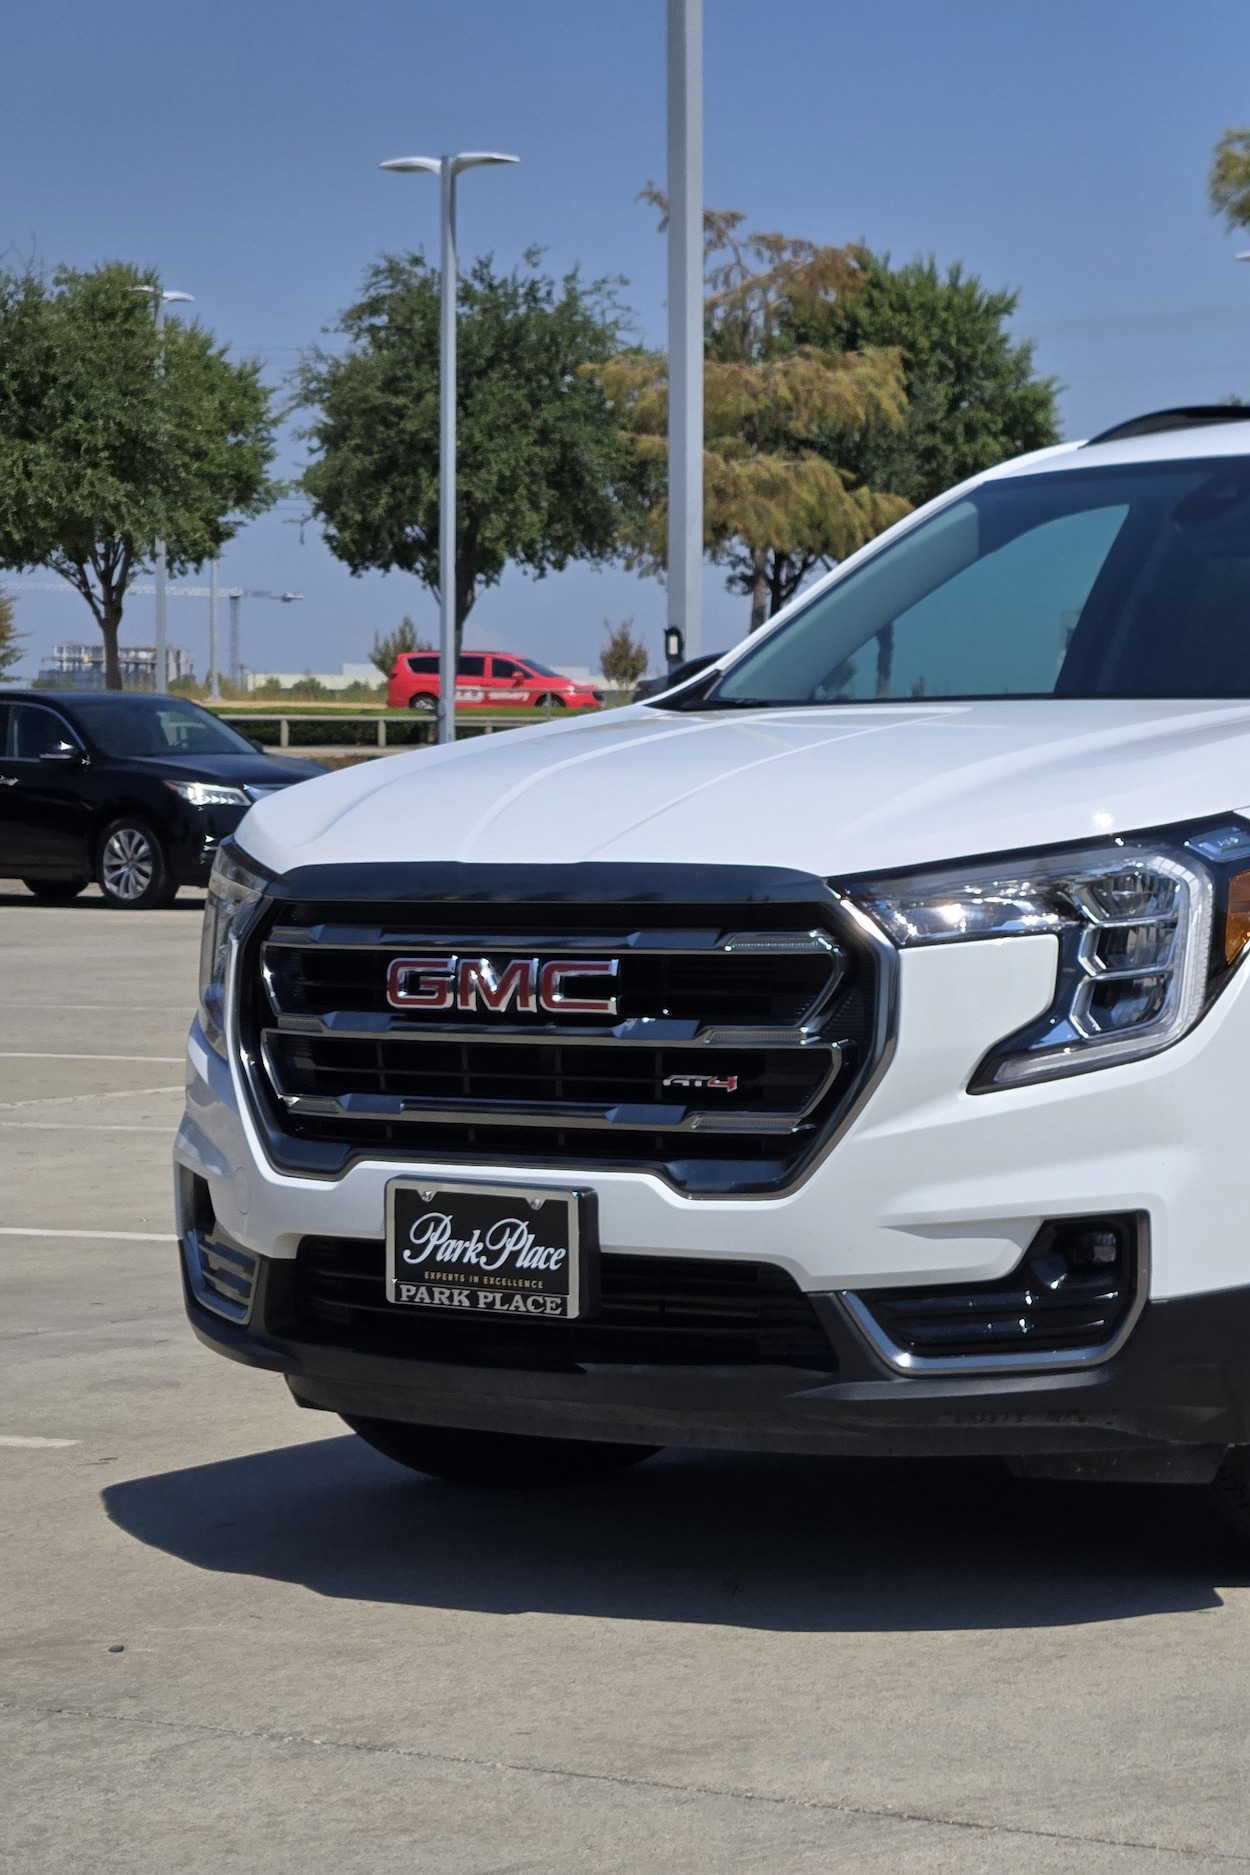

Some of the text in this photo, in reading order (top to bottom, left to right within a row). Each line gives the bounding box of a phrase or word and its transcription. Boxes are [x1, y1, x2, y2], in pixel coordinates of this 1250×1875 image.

[386, 955, 620, 1015] GMC
[662, 1074, 739, 1092] AT4
[403, 1212, 567, 1271] Park Place
[424, 1271, 544, 1289] EXPERTS IN EXCELLENCE
[400, 1284, 563, 1315] PARK PLACE
